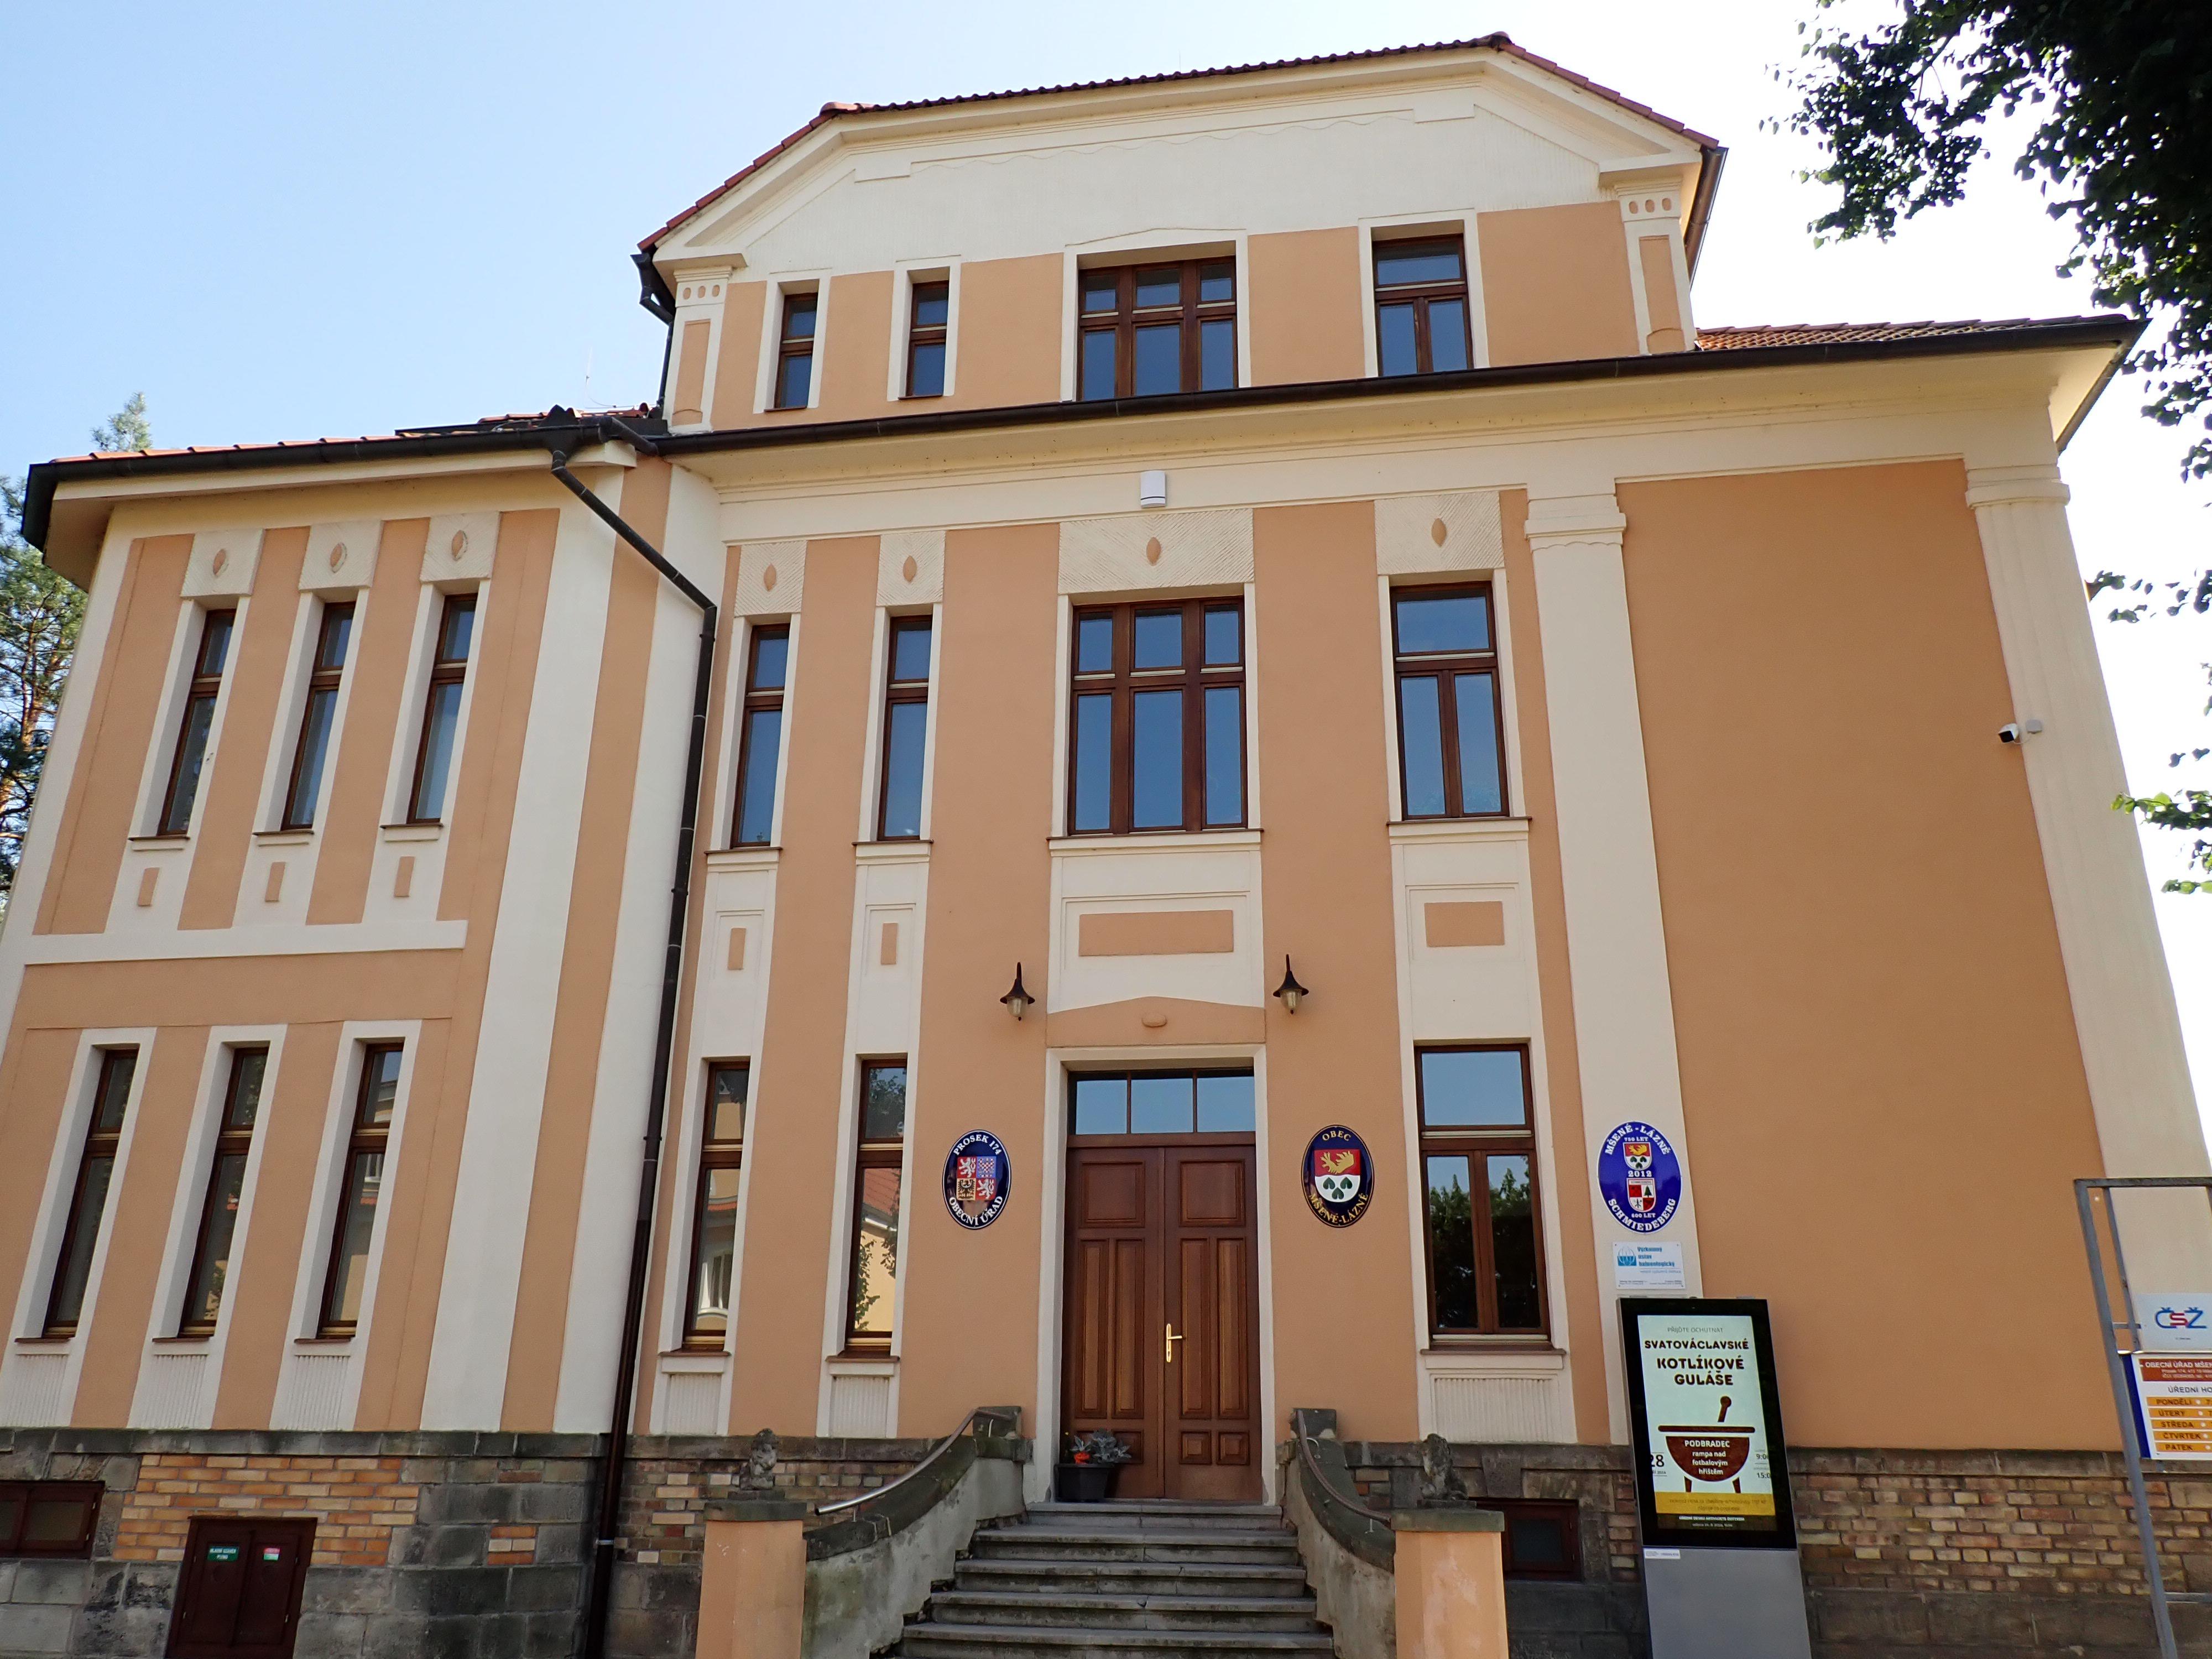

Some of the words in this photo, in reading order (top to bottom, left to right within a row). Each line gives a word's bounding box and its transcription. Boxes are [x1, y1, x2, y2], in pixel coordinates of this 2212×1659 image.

[953, 1134, 989, 1155] PROSEK
[989, 1140, 1002, 1155] 174
[1322, 1130, 1352, 1141] OBEC
[1605, 1124, 1633, 1155] MŠENÉ
[1640, 1125, 1671, 1155] LÁZNĚ
[949, 1197, 979, 1225] OBECNÍ
[980, 1196, 1003, 1223] ÚŘAD
[1608, 1198, 1676, 1231] SCHMIEDEBERG
[1645, 1338, 1749, 1349] SVATOVÁCLAVSKÉ
[1657, 1354, 1744, 1369] KOTLÍKOVÉ
[1674, 1370, 1734, 1385] GULÁŠE
